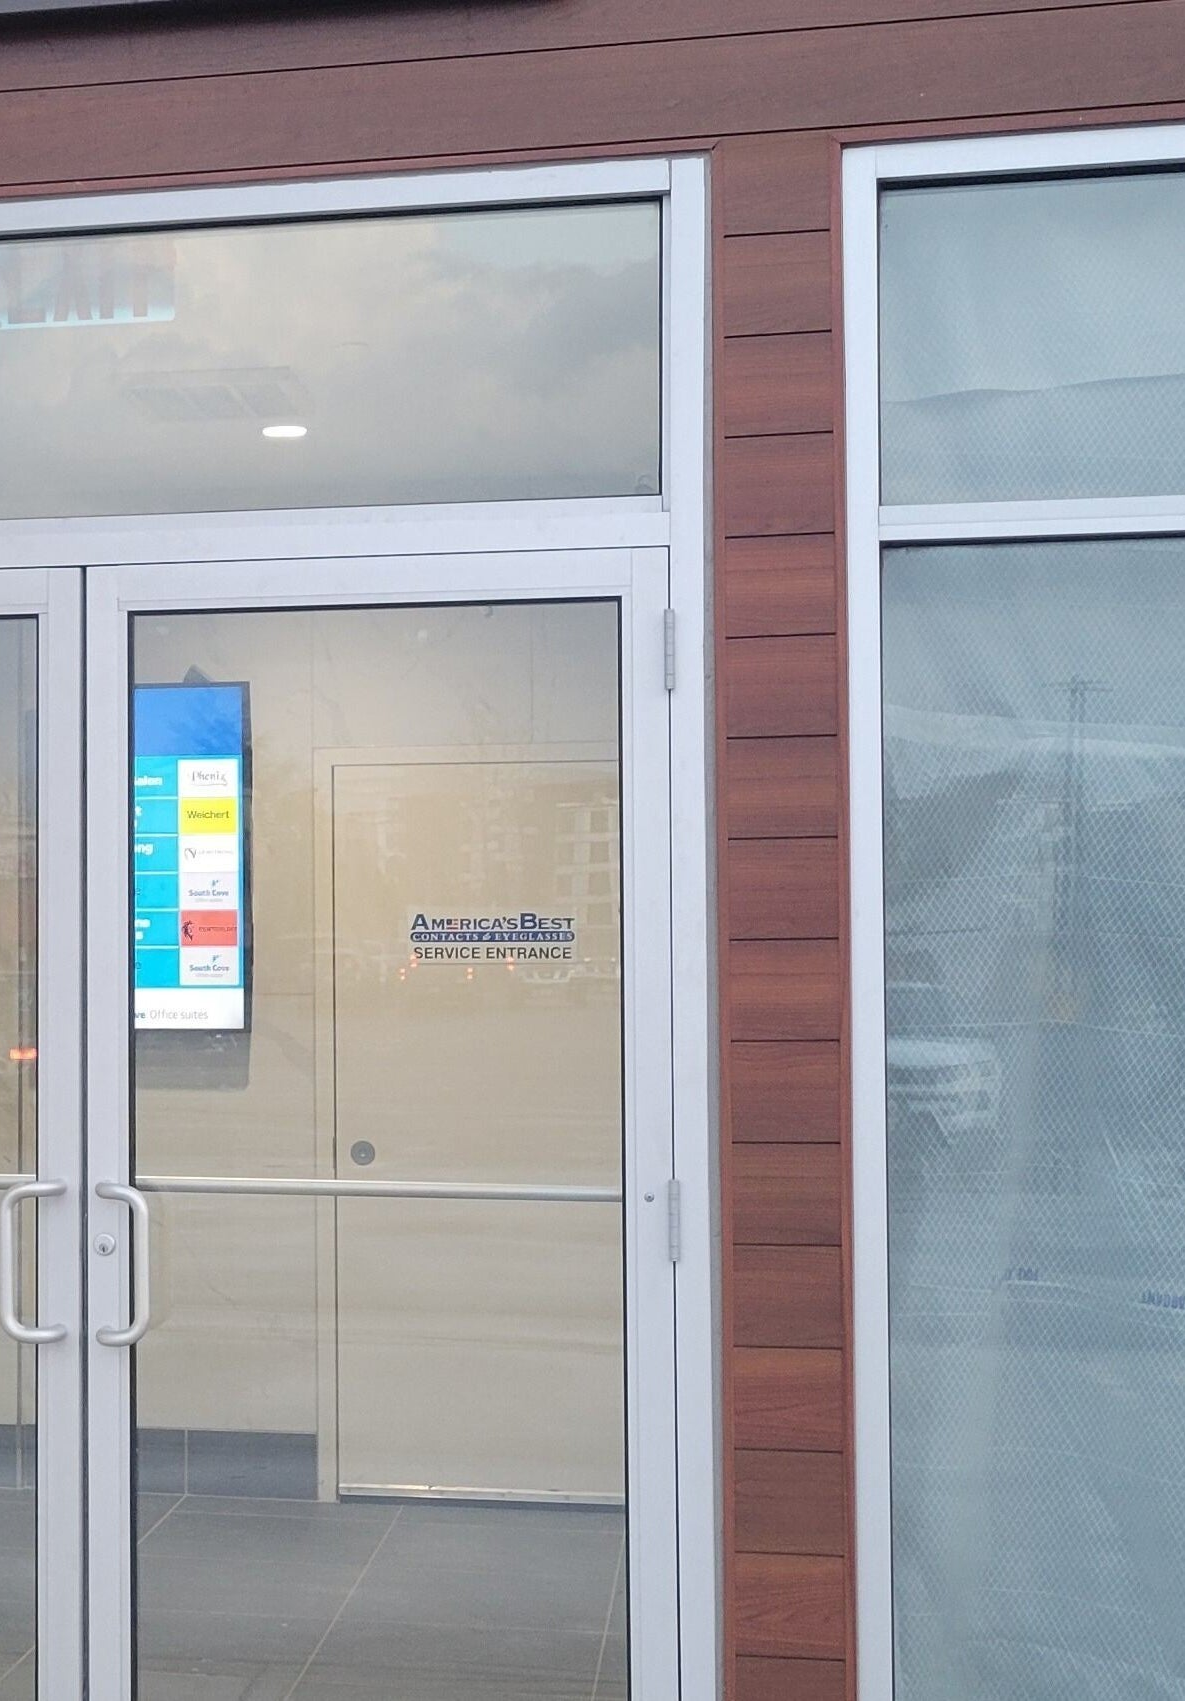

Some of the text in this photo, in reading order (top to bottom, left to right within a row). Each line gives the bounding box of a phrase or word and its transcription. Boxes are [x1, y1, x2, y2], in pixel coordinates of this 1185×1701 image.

[186, 810, 230, 819] Weichert
[188, 889, 229, 897] South Cove
[411, 912, 575, 931] AMERICA'S BEST
[413, 932, 574, 942] CONTACTS & EYEGLASSES
[414, 946, 572, 959] SERVICE ENTRANCE
[189, 964, 230, 972] South Cove
[149, 1009, 178, 1020] Office
[180, 1010, 209, 1020] suites
